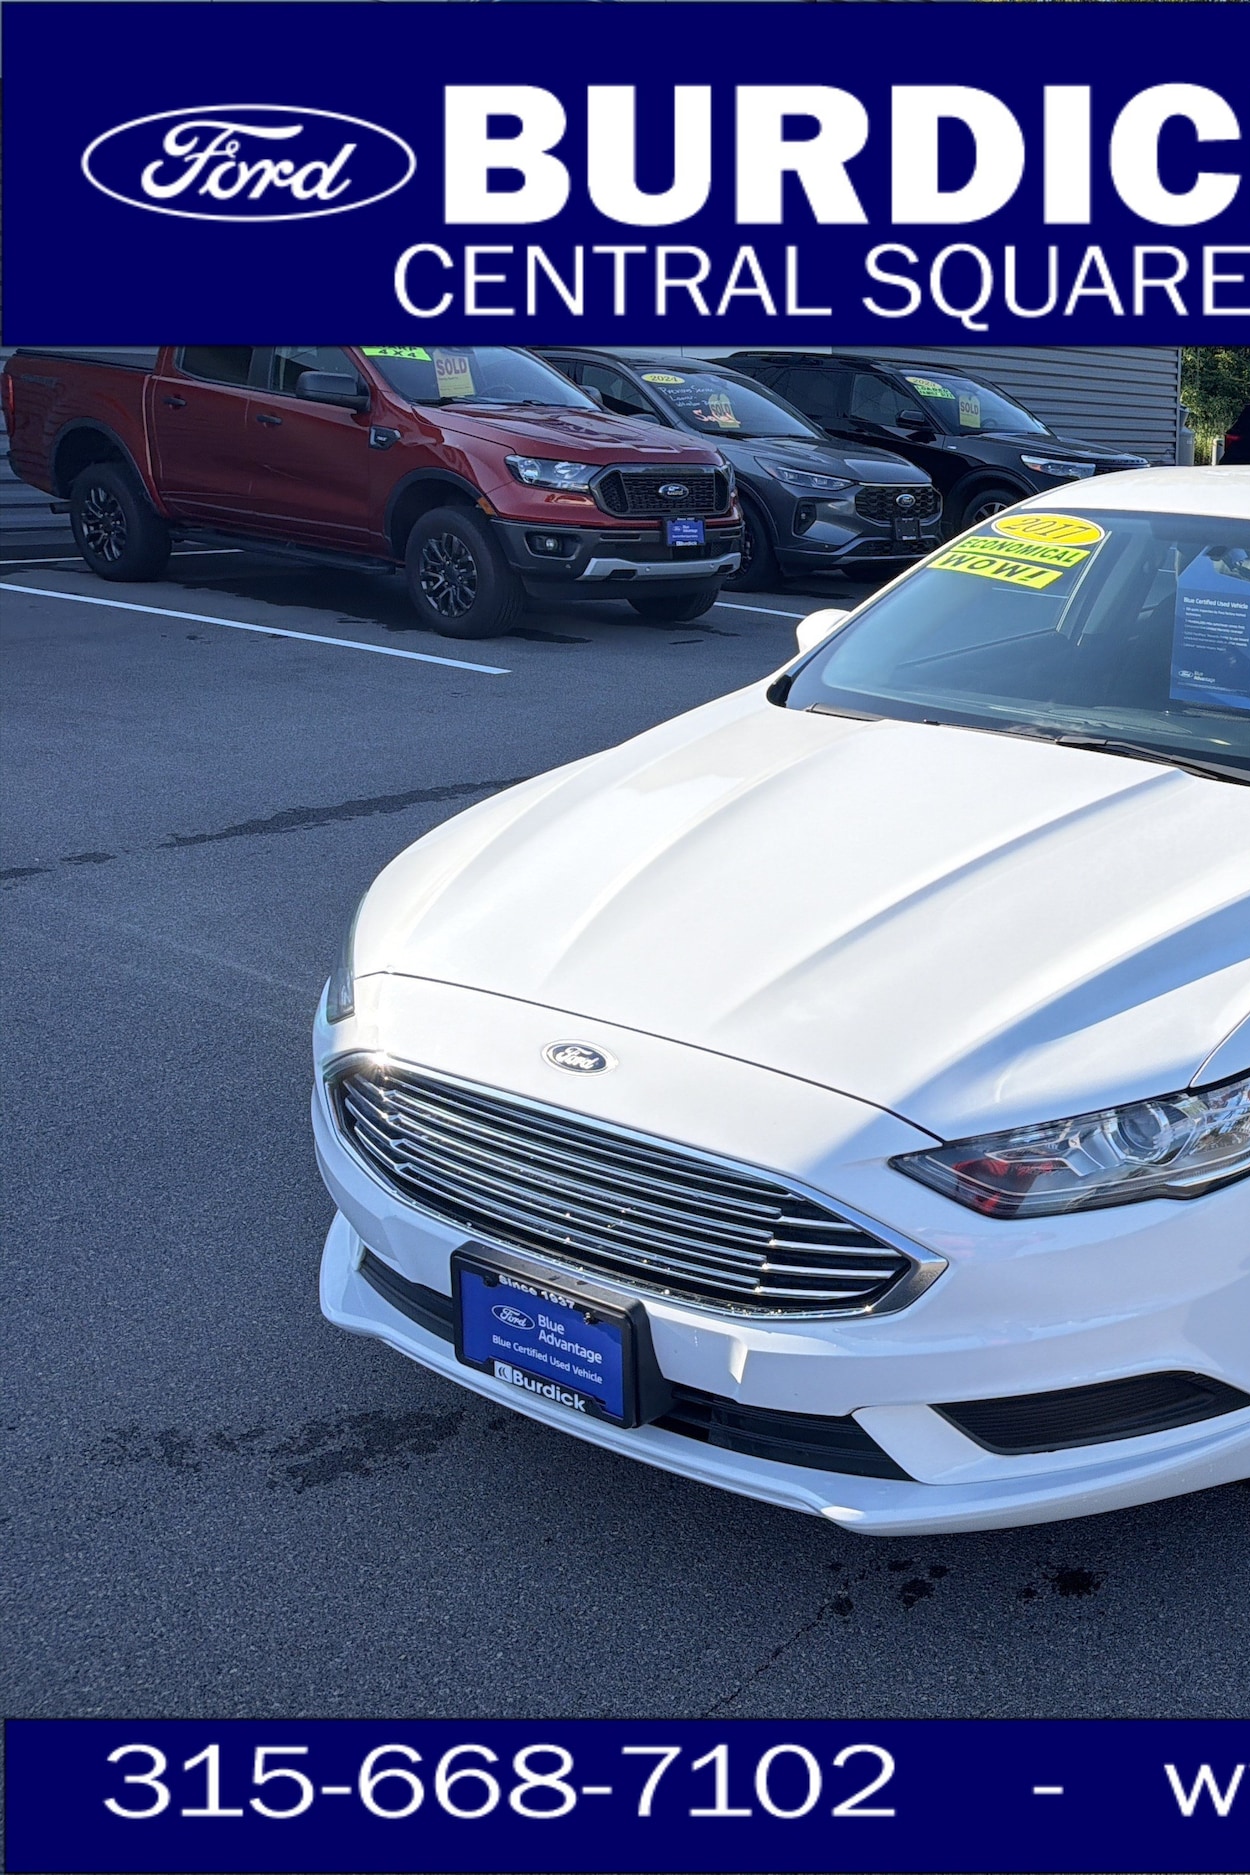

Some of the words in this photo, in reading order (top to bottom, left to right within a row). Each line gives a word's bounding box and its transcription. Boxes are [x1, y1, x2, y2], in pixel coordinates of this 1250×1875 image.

[436, 357, 468, 376] SOLD
[960, 401, 979, 415] SOLD
[1003, 518, 1091, 540] 2017
[957, 538, 1078, 563] ECONOMICAL
[939, 553, 1047, 582] WOW!
[1183, 596, 1195, 604] Blue
[1195, 598, 1217, 606] Certified
[1216, 600, 1230, 608] Used
[1230, 601, 1249, 610] Vehicle
[555, 1046, 600, 1070] Ford
[499, 1274, 538, 1296] Since
[537, 1313, 565, 1335] Blue
[538, 1329, 603, 1364] Advantage
[492, 1334, 512, 1349] Blue
[512, 1342, 548, 1362] Certified
[549, 1355, 571, 1372] Used
[572, 1364, 603, 1385] Vehicle
[512, 1369, 586, 1412] Burdick
